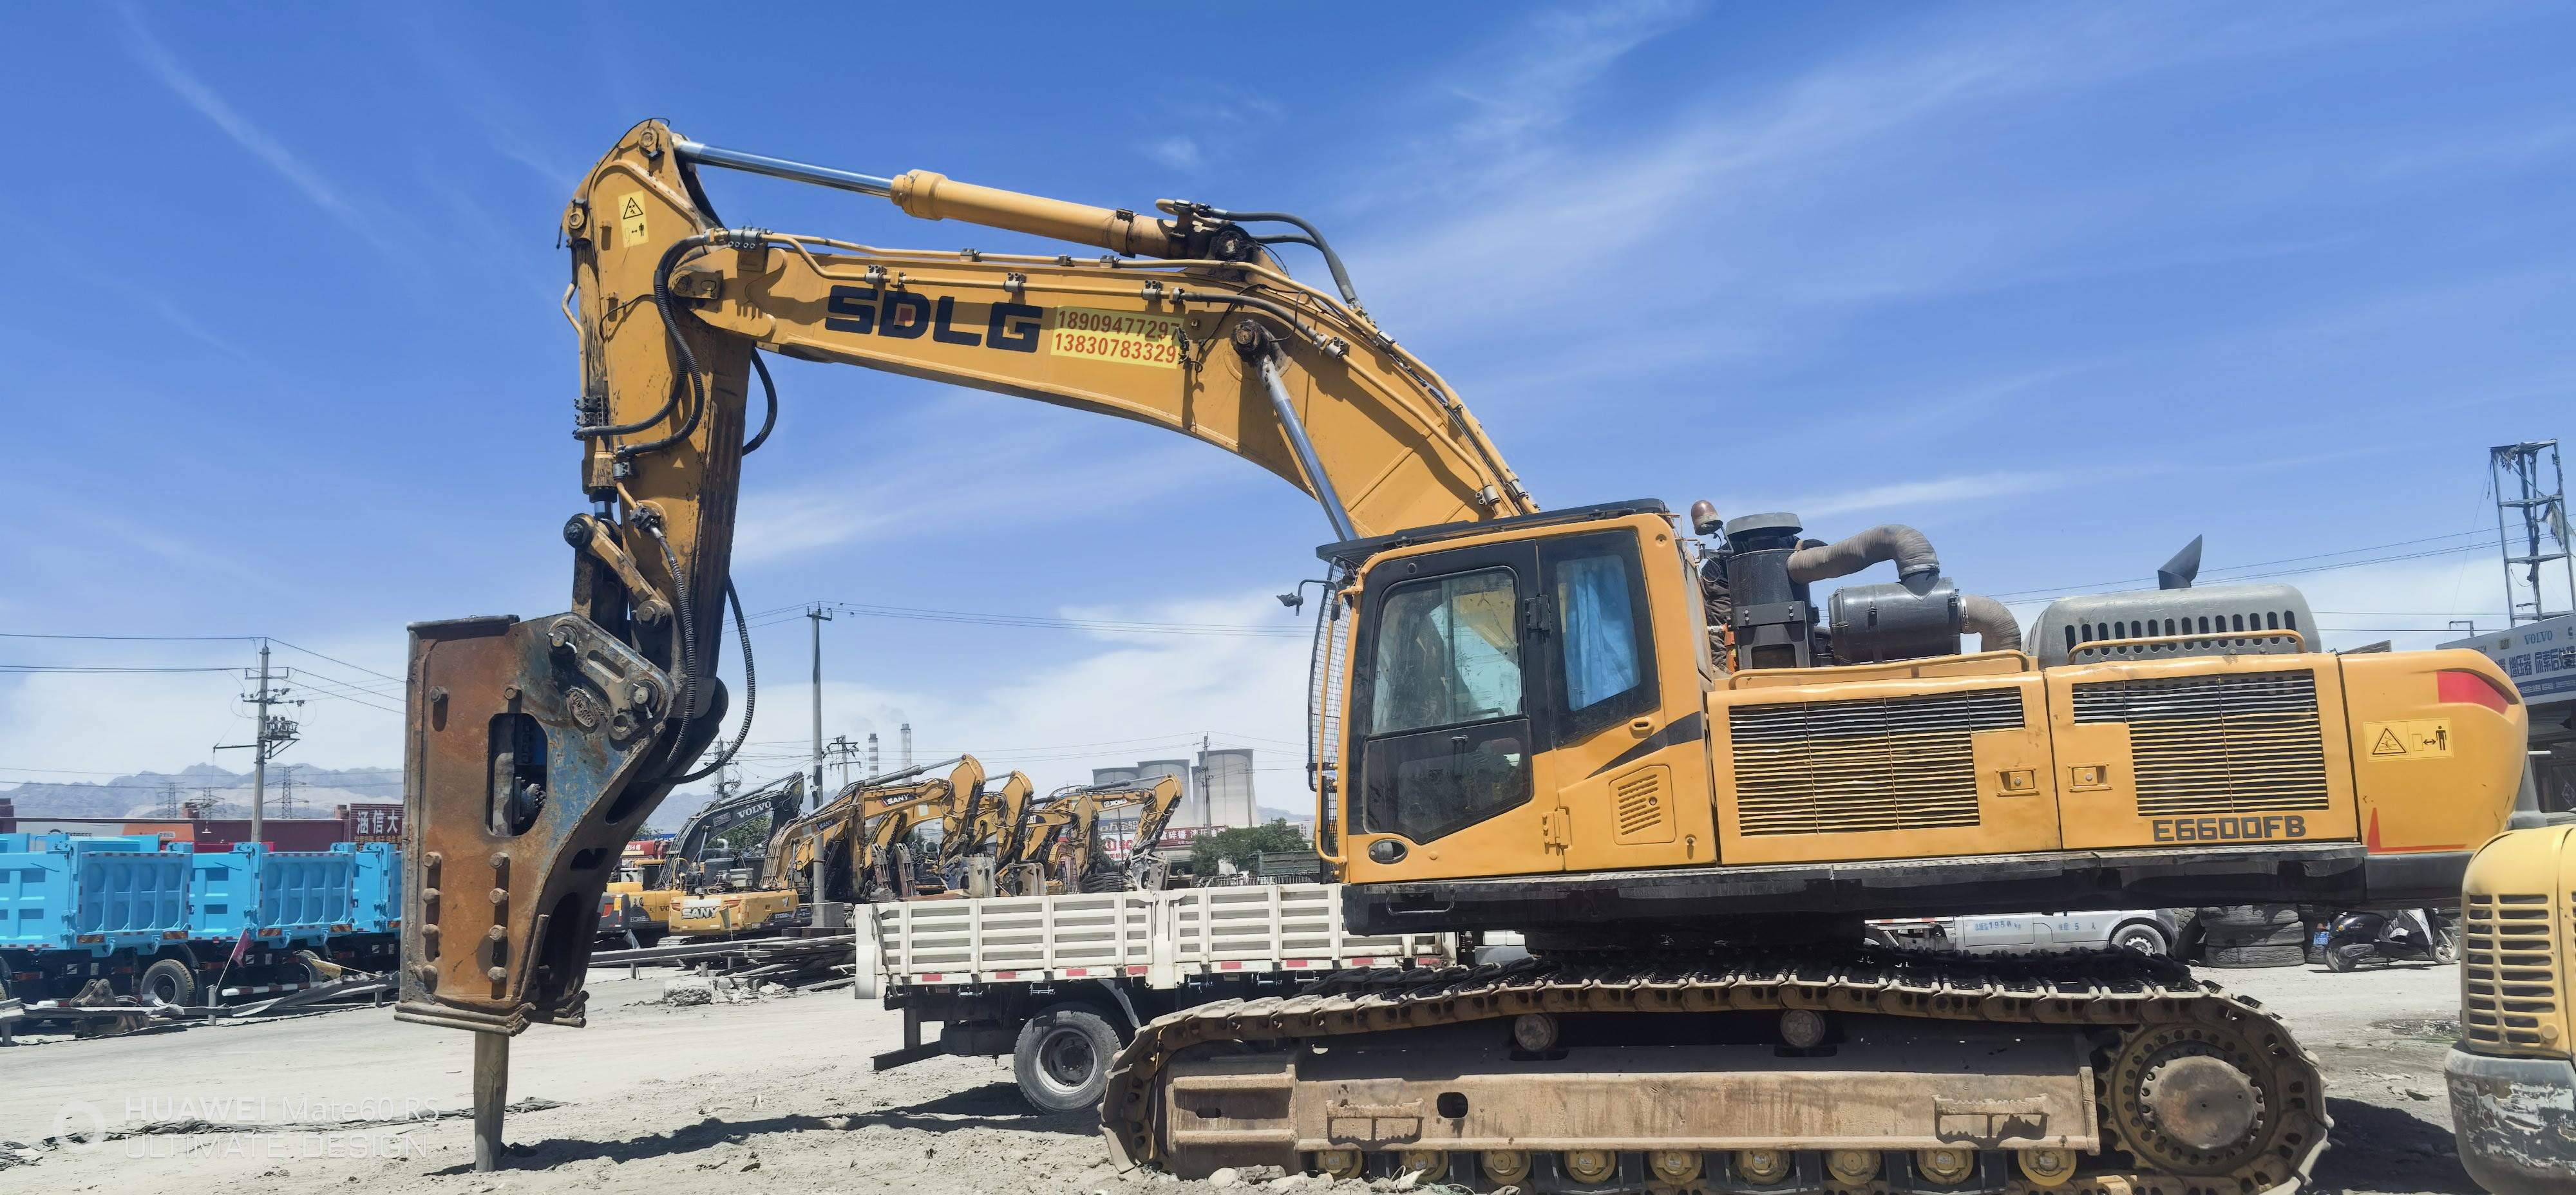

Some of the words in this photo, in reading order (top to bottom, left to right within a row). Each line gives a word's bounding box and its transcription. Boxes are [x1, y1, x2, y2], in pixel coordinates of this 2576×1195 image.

[825, 285, 1043, 353] SDLG
[1059, 310, 1180, 341] 18909477297
[1056, 333, 1177, 363] 13830783329
[2524, 630, 2553, 645] VOLVO
[737, 800, 772, 818] VOLVO
[887, 793, 909, 805] SANY
[2152, 815, 2306, 842] E6600FB
[681, 907, 721, 920] SANY
